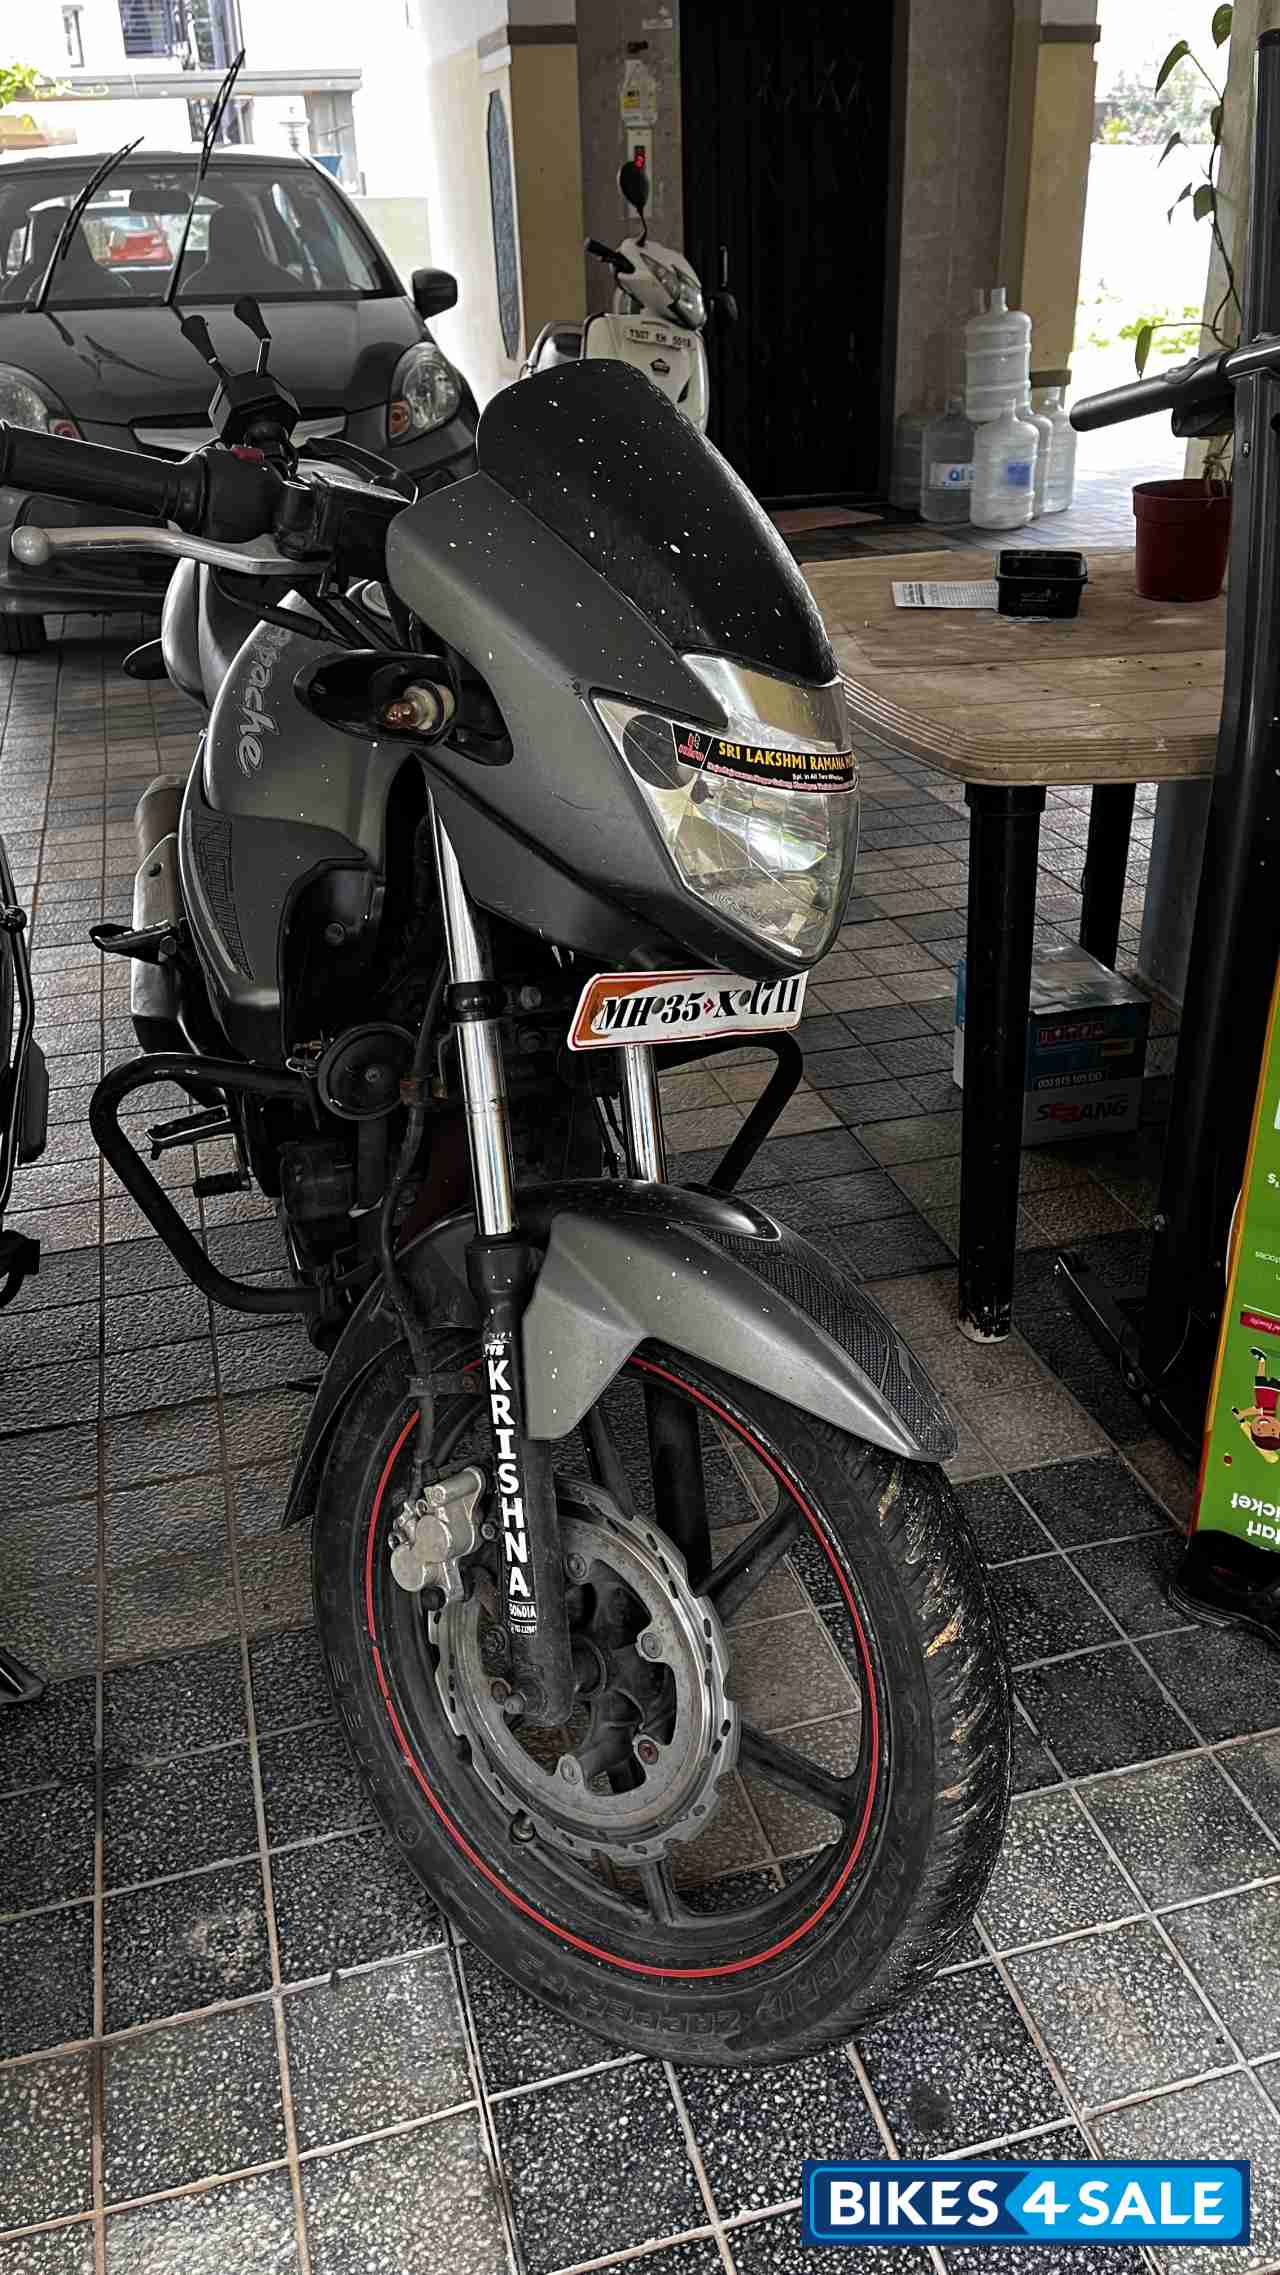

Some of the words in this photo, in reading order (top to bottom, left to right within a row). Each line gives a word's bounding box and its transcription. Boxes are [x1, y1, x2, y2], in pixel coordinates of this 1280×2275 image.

[719, 741, 741, 760] SRI
[746, 747, 807, 770] LAKSHMI
[597, 996, 655, 1031] MH
[660, 991, 705, 1024] 35
[713, 989, 741, 1019] X
[749, 977, 799, 1016] 1711
[487, 1359, 531, 1598] KRISHNA
